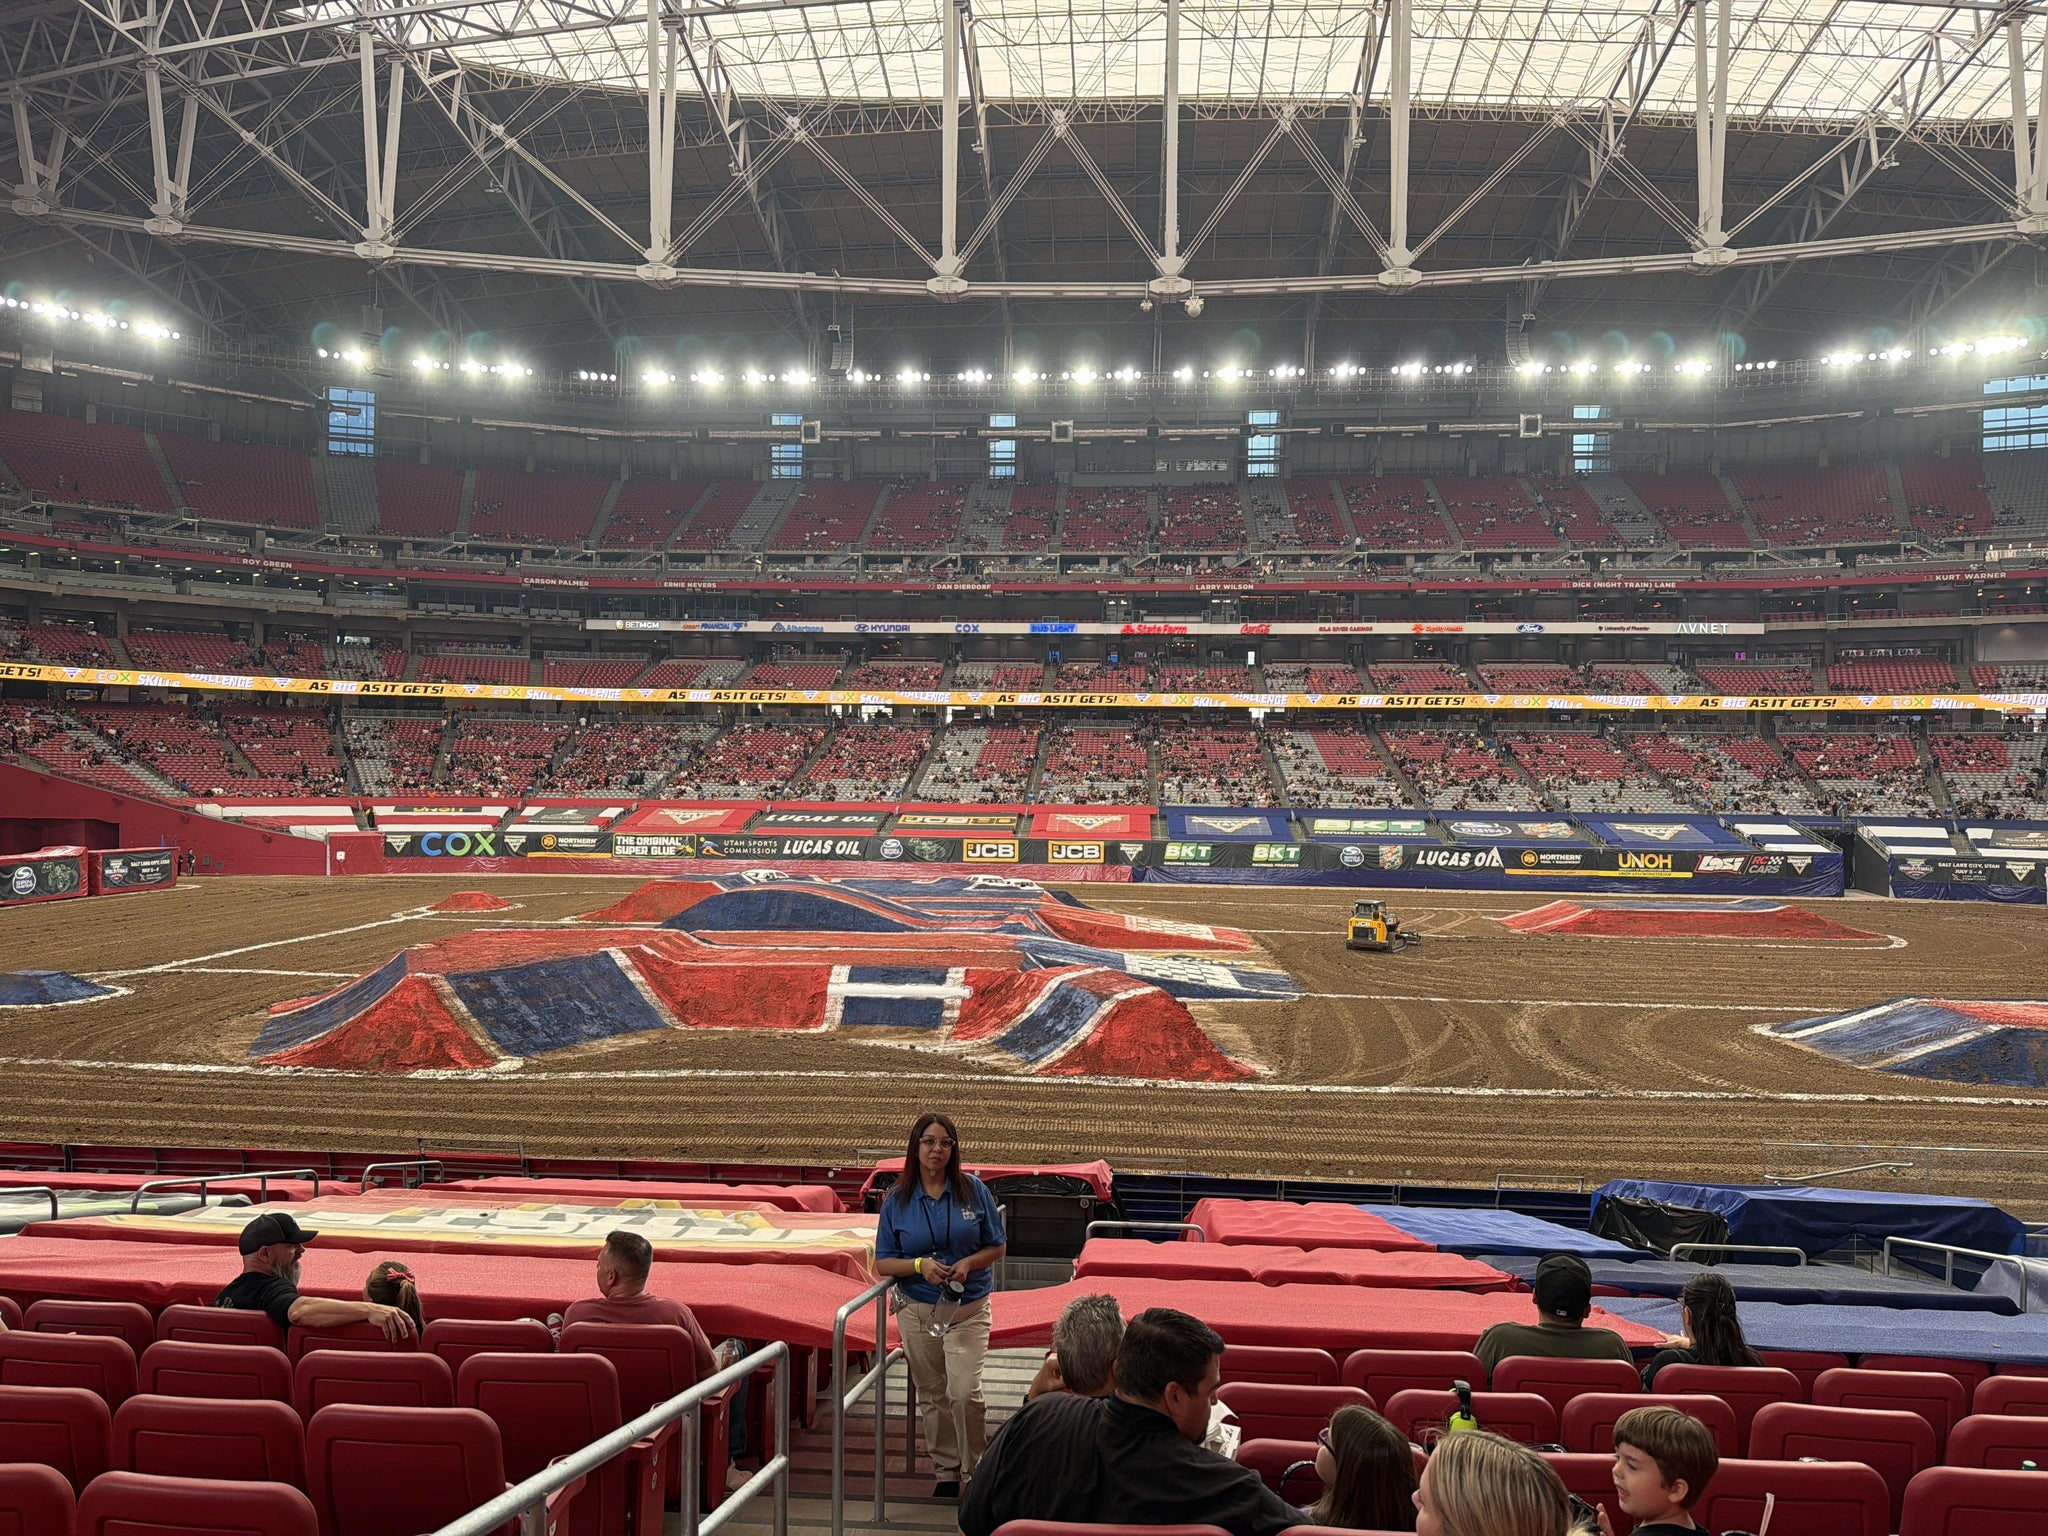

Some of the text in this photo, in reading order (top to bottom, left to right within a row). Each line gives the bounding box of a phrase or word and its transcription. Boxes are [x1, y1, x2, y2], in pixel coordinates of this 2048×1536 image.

[242, 557, 261, 566] ROY
[263, 559, 293, 569] GREEN
[1935, 573, 1961, 582] KURT
[1964, 571, 2007, 580] WARNER
[524, 577, 557, 585] CARSON
[558, 578, 589, 587] PALMER
[687, 581, 717, 589] NEVERS
[1593, 581, 1622, 589] (NIGHT
[1624, 581, 1653, 589] TRAIN)
[1654, 581, 1676, 589] LANE
[625, 621, 660, 629] BETMGM
[786, 624, 824, 633] Albertsons
[871, 624, 911, 632] HYUNDAI
[955, 624, 980, 633] COX
[1030, 624, 1076, 633] BUD LIGHT
[1137, 624, 1188, 634] State Farm
[1604, 625, 1625, 633] University
[1676, 623, 1729, 634] AVNET
[96, 672, 131, 683] COX
[309, 682, 444, 695] AS BIG AS IT GETS!
[492, 688, 521, 698] COX
[668, 691, 787, 701] AS BIG AS IT GETS!
[829, 693, 855, 702] COX
[998, 695, 1118, 704] AS BIG AS IT GETS!
[1161, 695, 1188, 704] COX
[1337, 696, 1466, 706] AS BIG AS IT GETS!
[1512, 697, 1541, 706] COX
[1700, 698, 1837, 708] AS BIG AS IT GETS!
[1891, 697, 1925, 707] COX
[765, 814, 839, 823] LUCAS
[1315, 820, 1422, 830] BKT
[420, 832, 496, 857] COX
[616, 836, 682, 846] THE ORIGINAL
[615, 846, 676, 856] SUPER GLUE
[783, 839, 833, 856] LUCAS
[967, 843, 1015, 858] JCB
[1052, 845, 1100, 859] JCB
[1165, 845, 1211, 858] BKT
[1253, 847, 1300, 859] BKT
[1416, 850, 1472, 867] LUCAS
[1618, 851, 1672, 868] UNOH
[1751, 856, 1769, 865] RC
[1748, 865, 1781, 874] CARS
